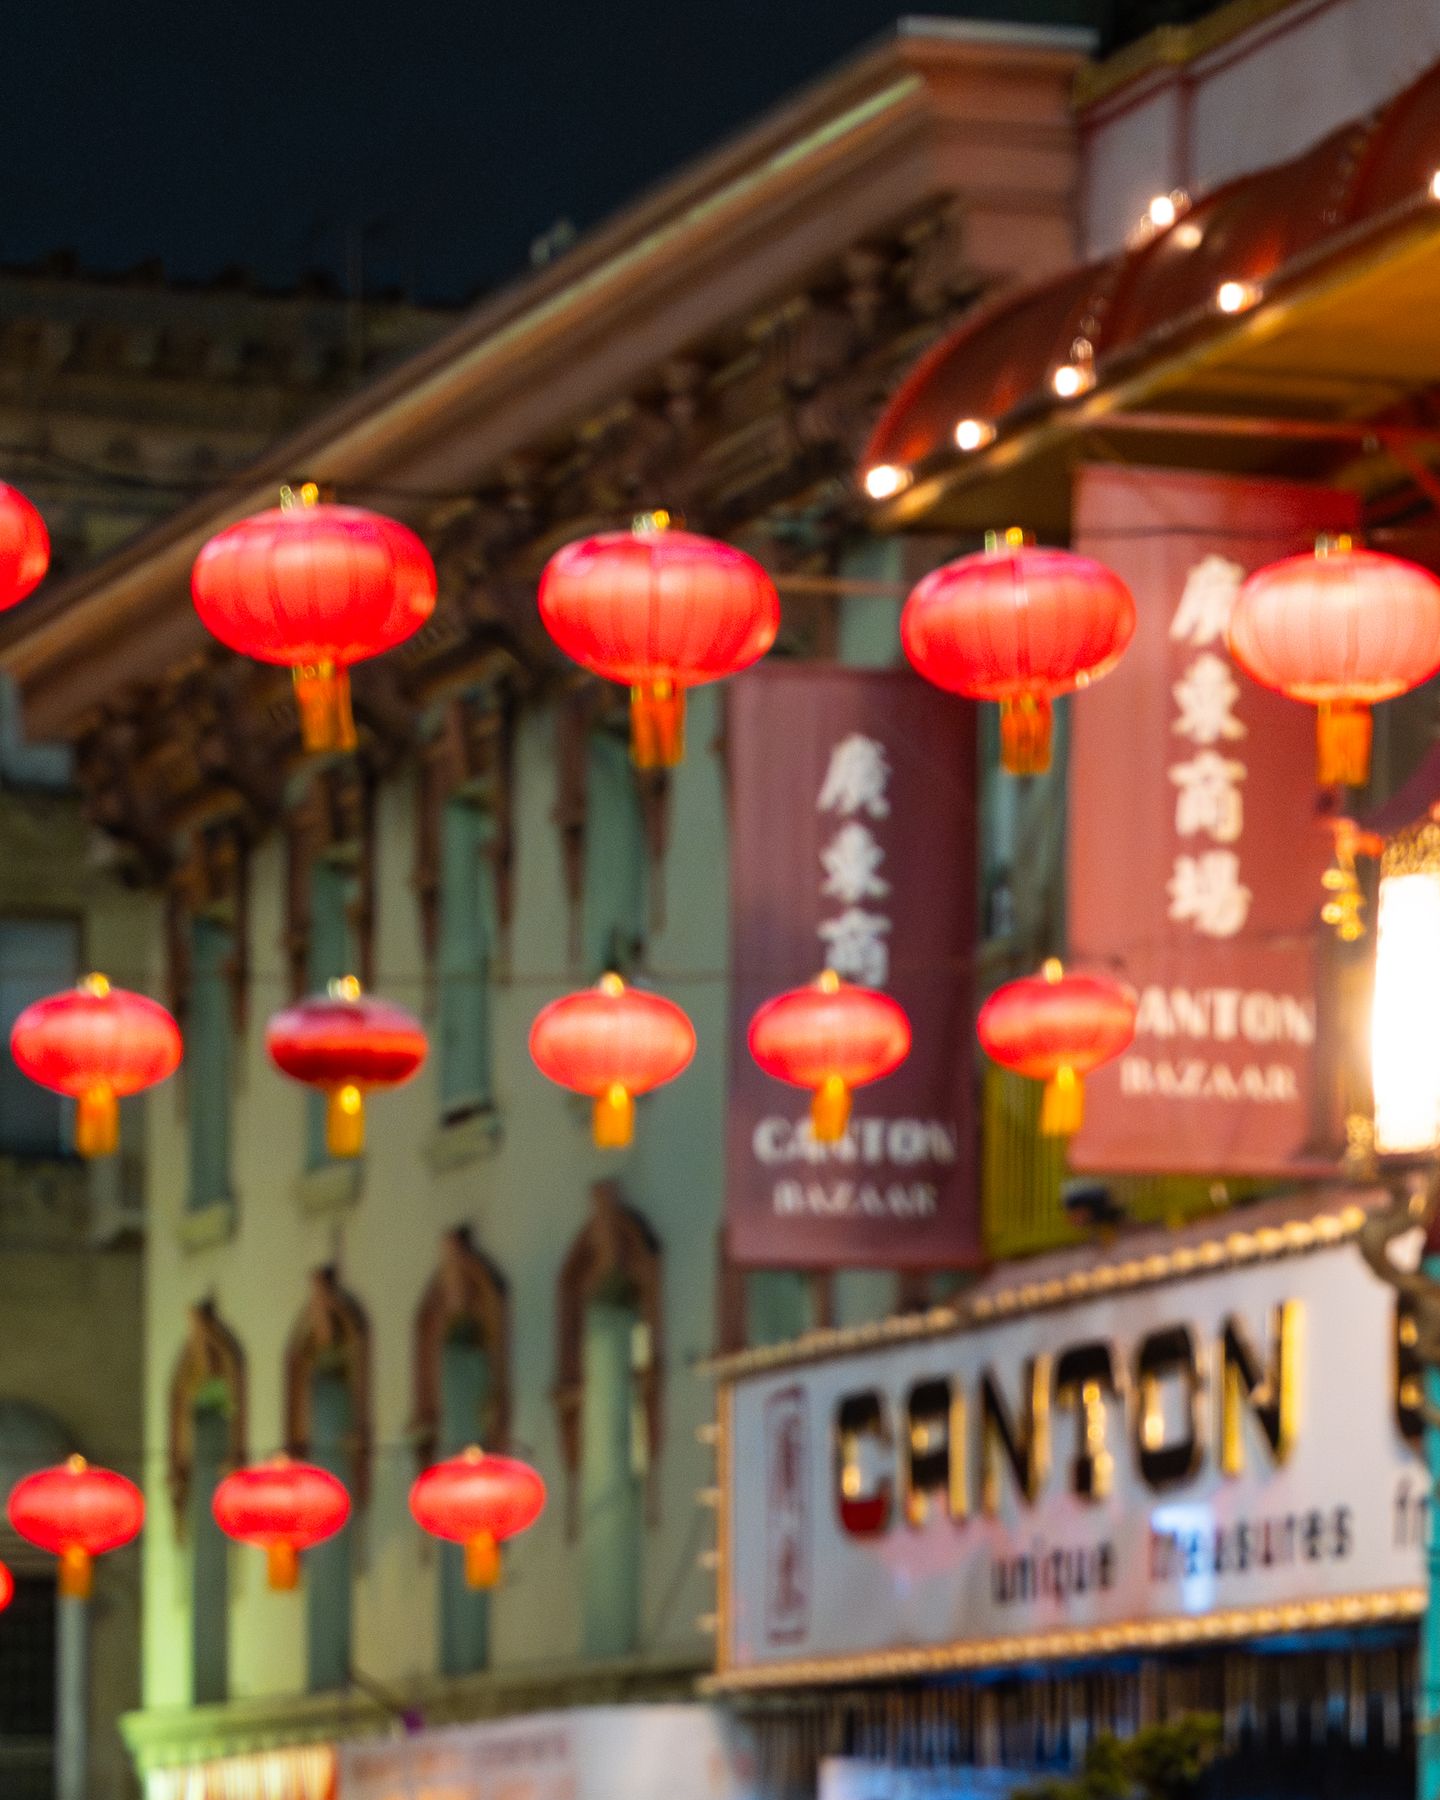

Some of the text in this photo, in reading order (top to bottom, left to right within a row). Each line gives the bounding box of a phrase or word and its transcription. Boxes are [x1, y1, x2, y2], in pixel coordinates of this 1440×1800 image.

[1134, 984, 1318, 1048] ANTON
[1118, 1054, 1299, 1104] BAZAAR
[771, 1180, 939, 1217] BAZAAR
[835, 1297, 1306, 1546] CANTON
[991, 1538, 1114, 1607] unique
